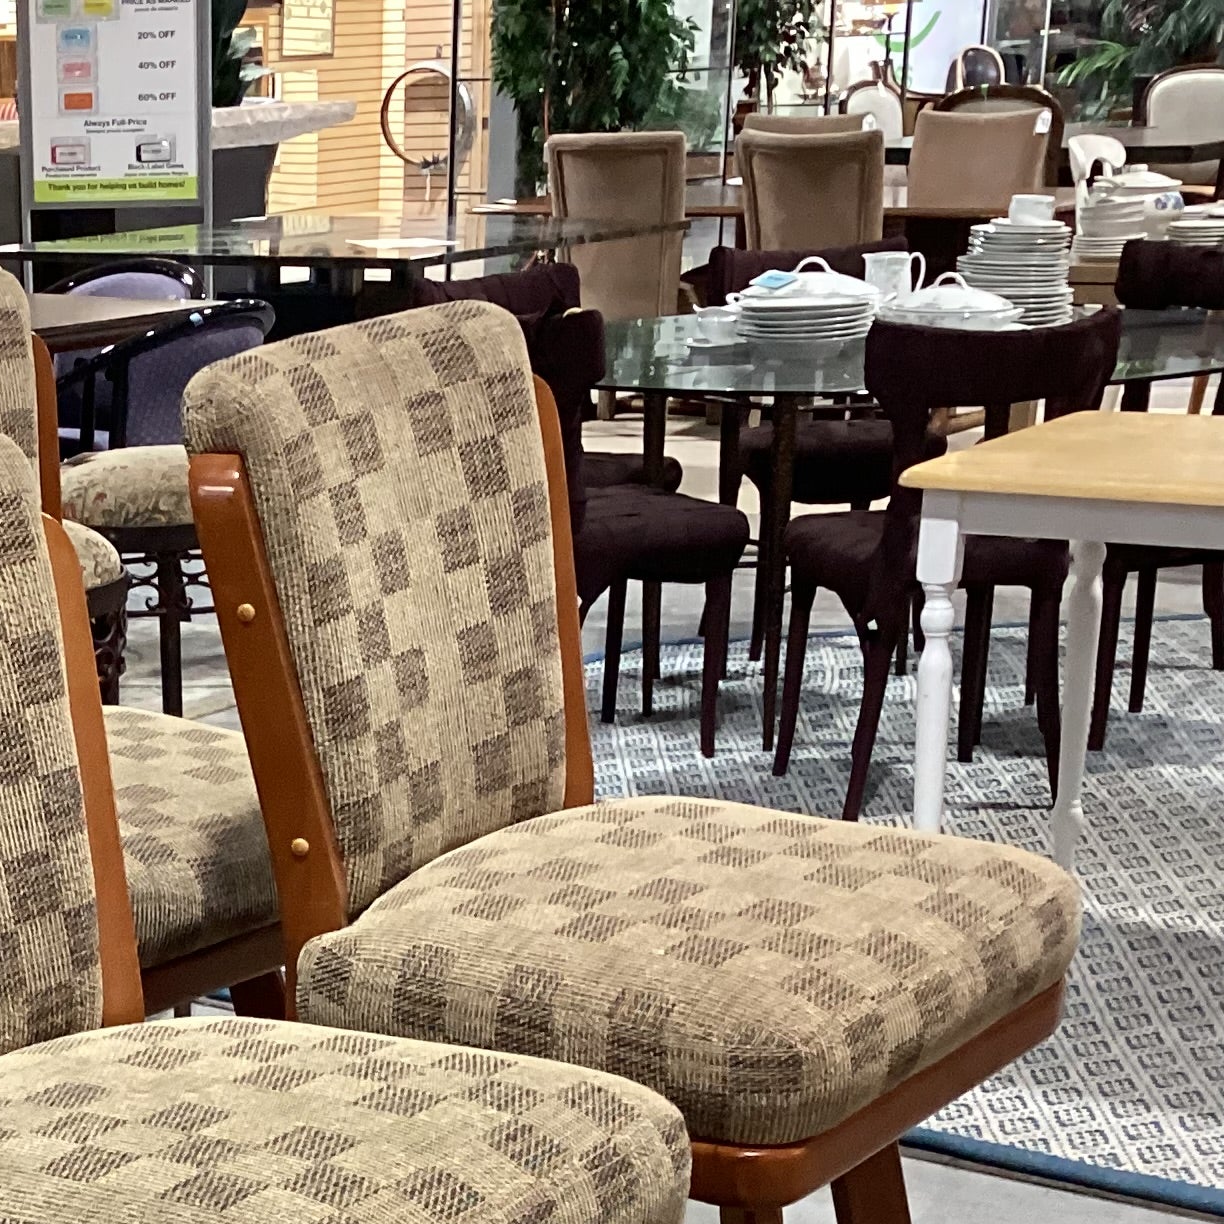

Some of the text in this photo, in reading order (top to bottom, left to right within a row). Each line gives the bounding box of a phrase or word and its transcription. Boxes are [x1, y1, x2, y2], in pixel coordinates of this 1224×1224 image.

[137, 29, 175, 40] 20% OFF
[138, 60, 176, 70] 40% OFF
[159, 92, 176, 101] OFF
[84, 119, 111, 128] Always
[48, 183, 71, 191] Thank
[72, 183, 87, 192] you
[87, 182, 98, 190] for
[99, 181, 127, 192] helping
[139, 180, 157, 189] build
